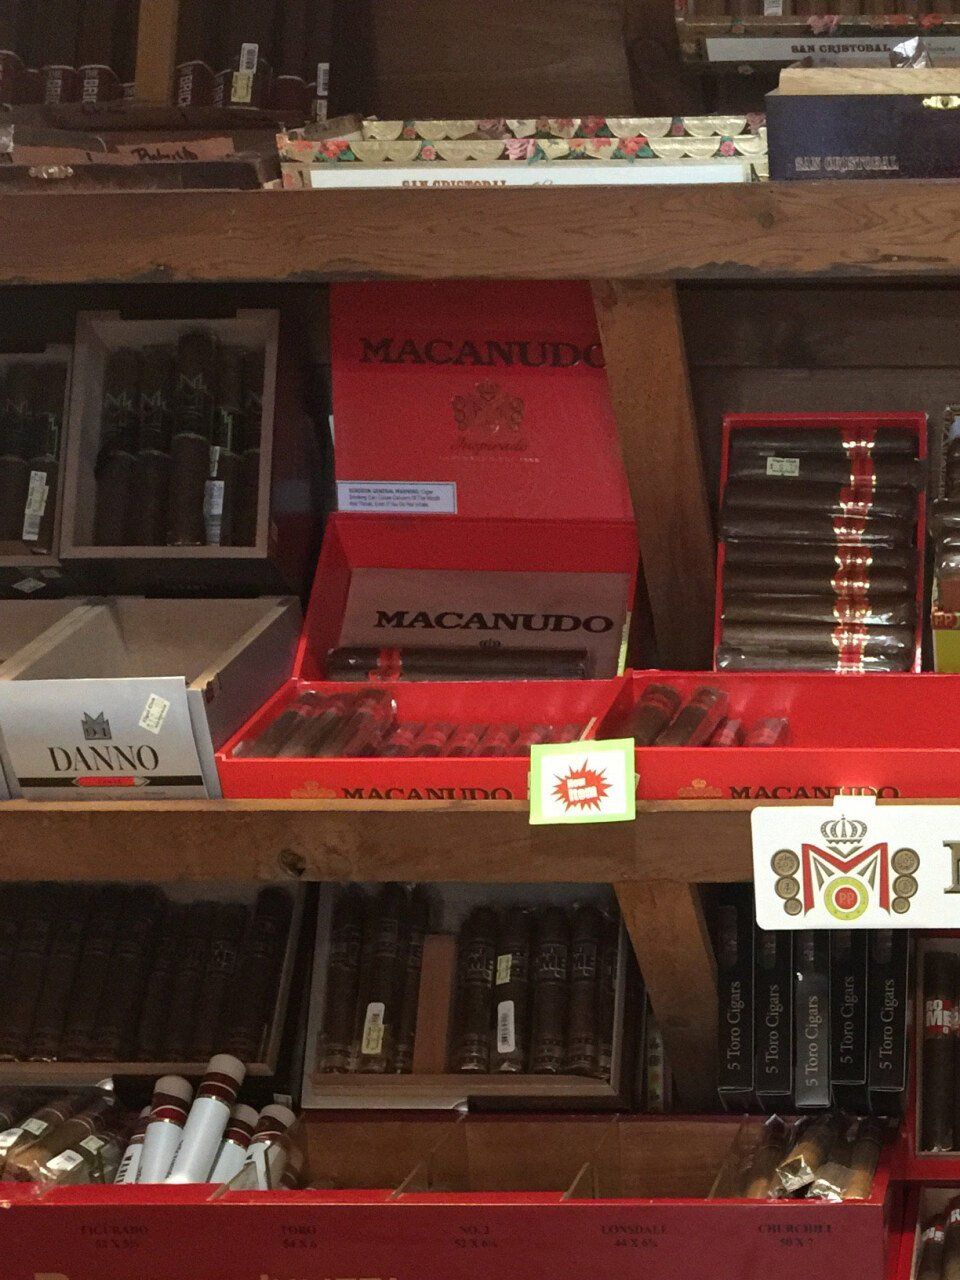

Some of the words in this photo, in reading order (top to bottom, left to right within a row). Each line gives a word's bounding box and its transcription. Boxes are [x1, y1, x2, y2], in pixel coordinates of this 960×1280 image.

[358, 336, 606, 369] MACANUDO
[372, 609, 614, 634] MACANUDO
[47, 744, 160, 772] DANNO
[728, 980, 745, 1025] Cigars
[766, 984, 783, 1027] Cigars
[841, 976, 858, 1018] Cigars
[880, 979, 899, 1022] Cigars
[805, 995, 822, 1039] Cigars
[727, 1026, 741, 1059] Toro
[765, 1029, 779, 1063] Toro
[840, 1019, 853, 1052] Toro
[879, 1025, 893, 1058] Toro
[727, 1061, 741, 1071] 5
[765, 1065, 779, 1074] 5
[805, 1042, 818, 1074] Toro
[840, 1055, 853, 1064] 5
[879, 1061, 892, 1070] 5
[805, 1078, 818, 1087] 5
